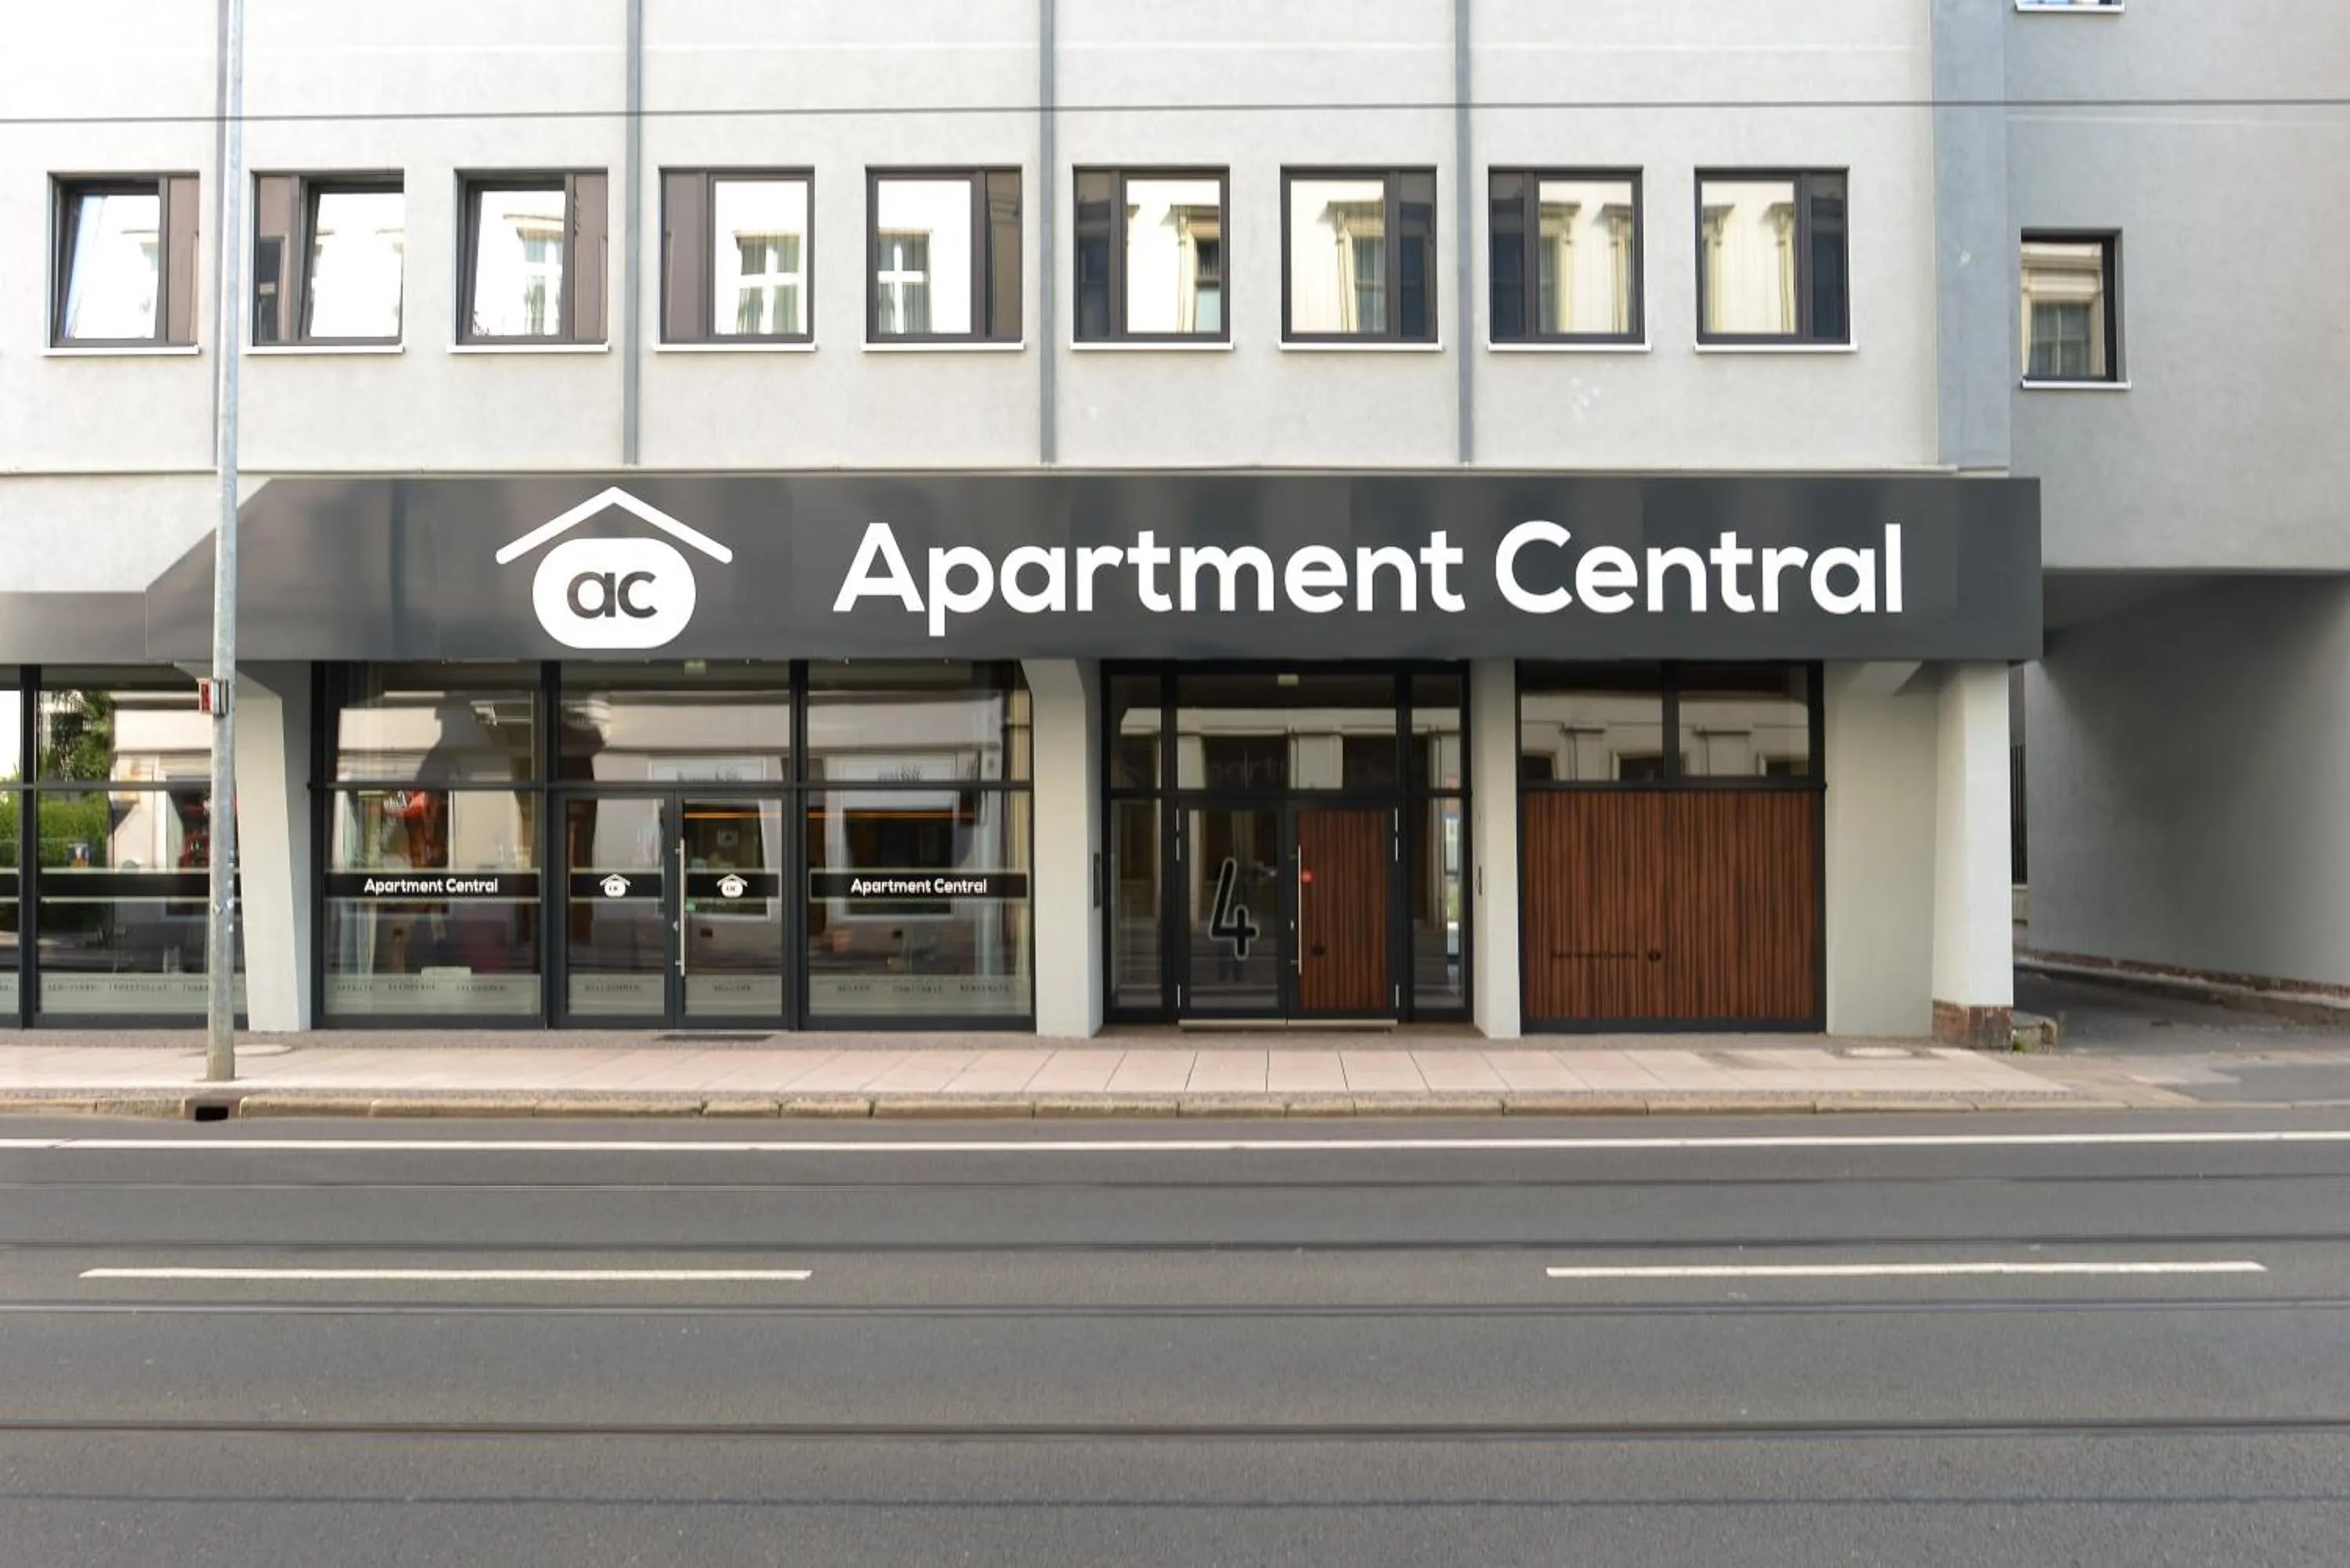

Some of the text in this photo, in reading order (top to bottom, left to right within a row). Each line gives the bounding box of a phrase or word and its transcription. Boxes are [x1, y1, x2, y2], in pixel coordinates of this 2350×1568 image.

[566, 571, 658, 620] ac
[833, 521, 1903, 637] Apartment Central
[363, 878, 498, 896] Apartment Central
[851, 878, 987, 896] Apartment Central
[1208, 857, 1260, 961] 4
